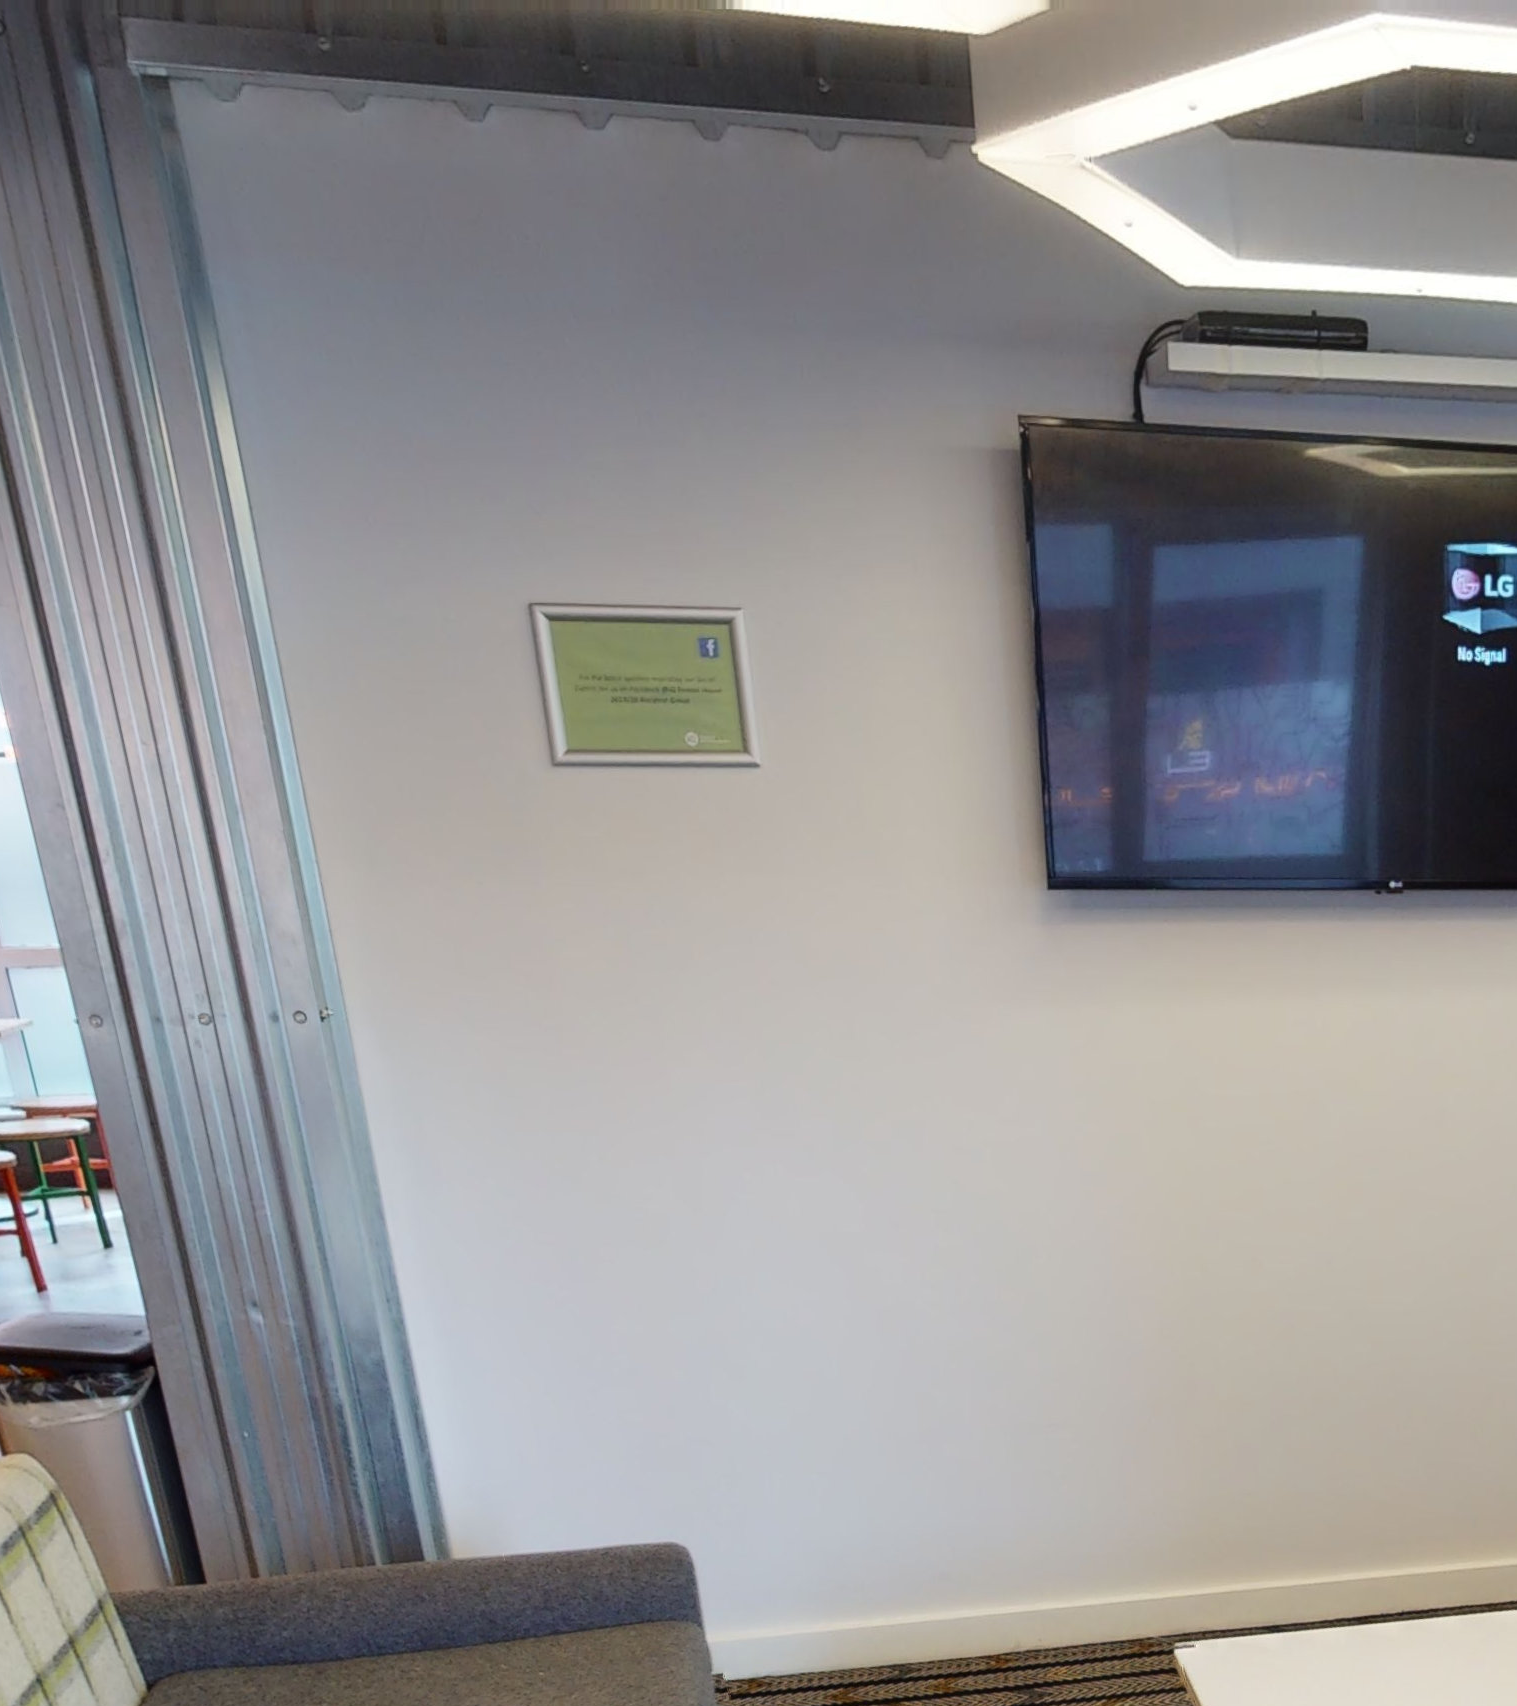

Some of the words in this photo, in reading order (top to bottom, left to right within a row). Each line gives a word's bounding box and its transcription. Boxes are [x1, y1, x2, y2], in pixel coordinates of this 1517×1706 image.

[1484, 573, 1514, 598] LG
[1457, 645, 1473, 662] No
[1474, 646, 1507, 666] Signal
